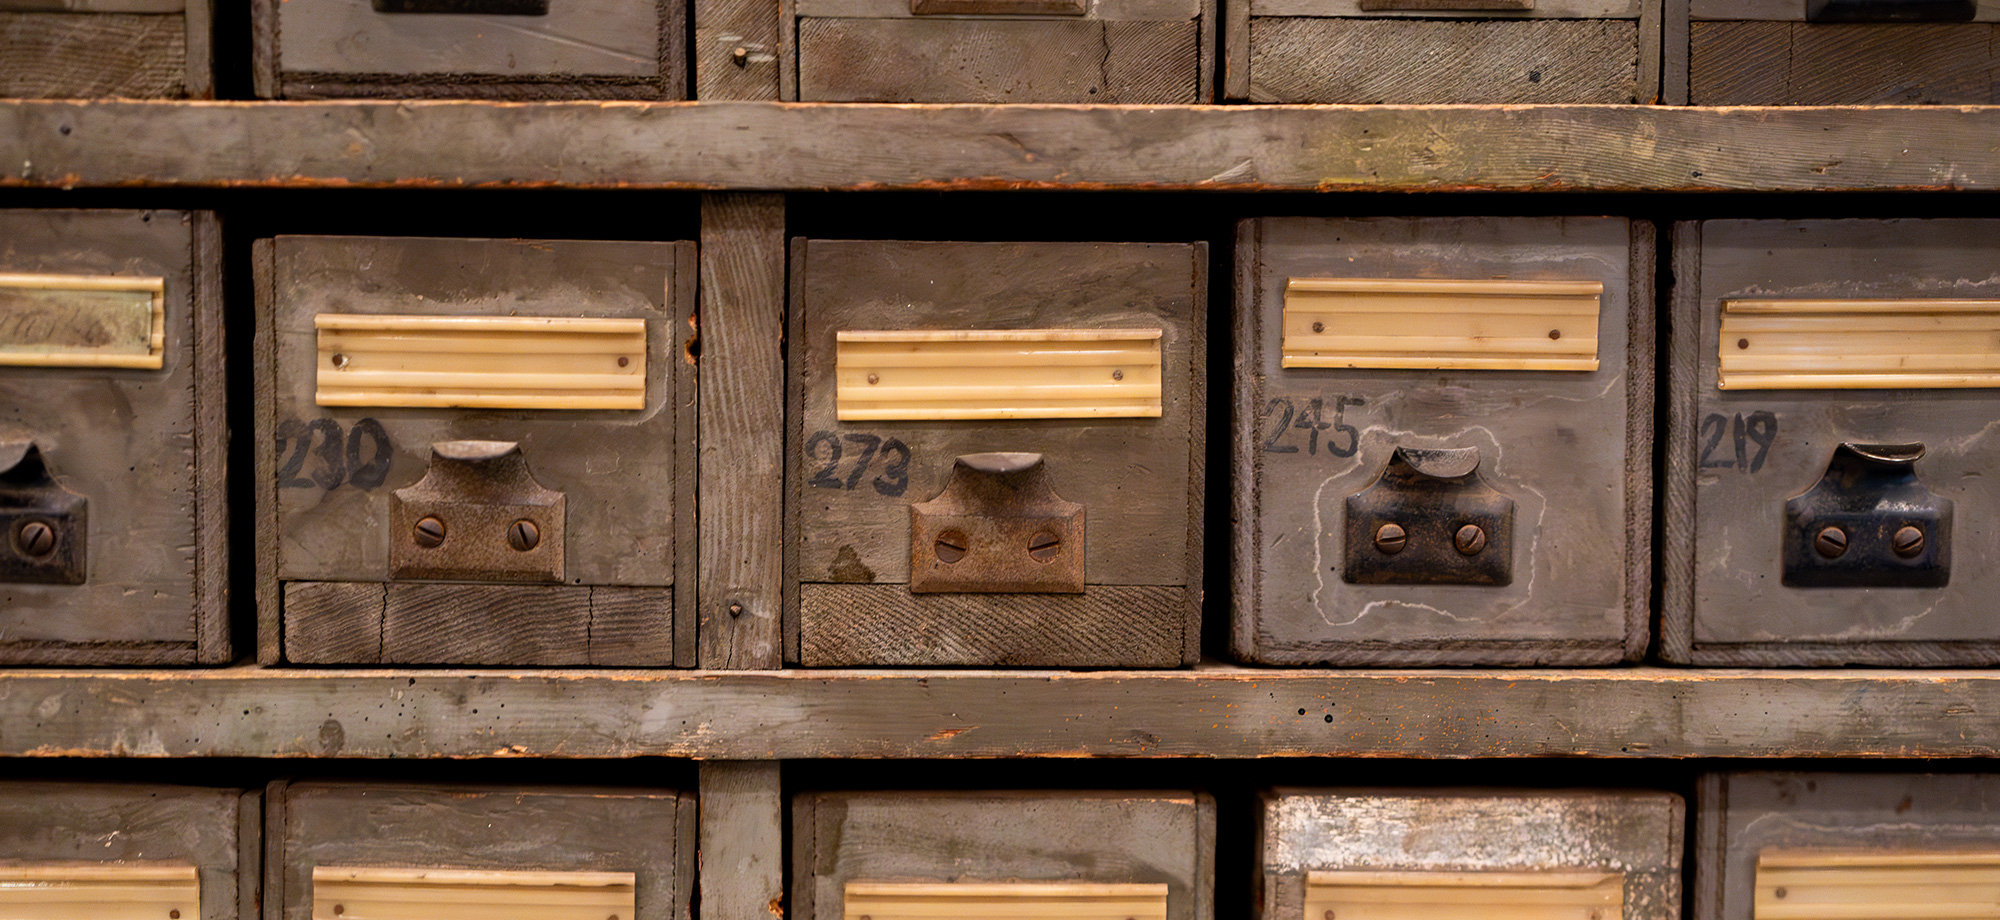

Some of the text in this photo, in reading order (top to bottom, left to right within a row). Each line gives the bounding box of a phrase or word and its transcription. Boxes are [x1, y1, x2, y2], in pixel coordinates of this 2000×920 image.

[277, 417, 393, 491] 230
[1263, 396, 1365, 458] 245
[1699, 410, 1778, 474] 219
[805, 430, 911, 497] 273
